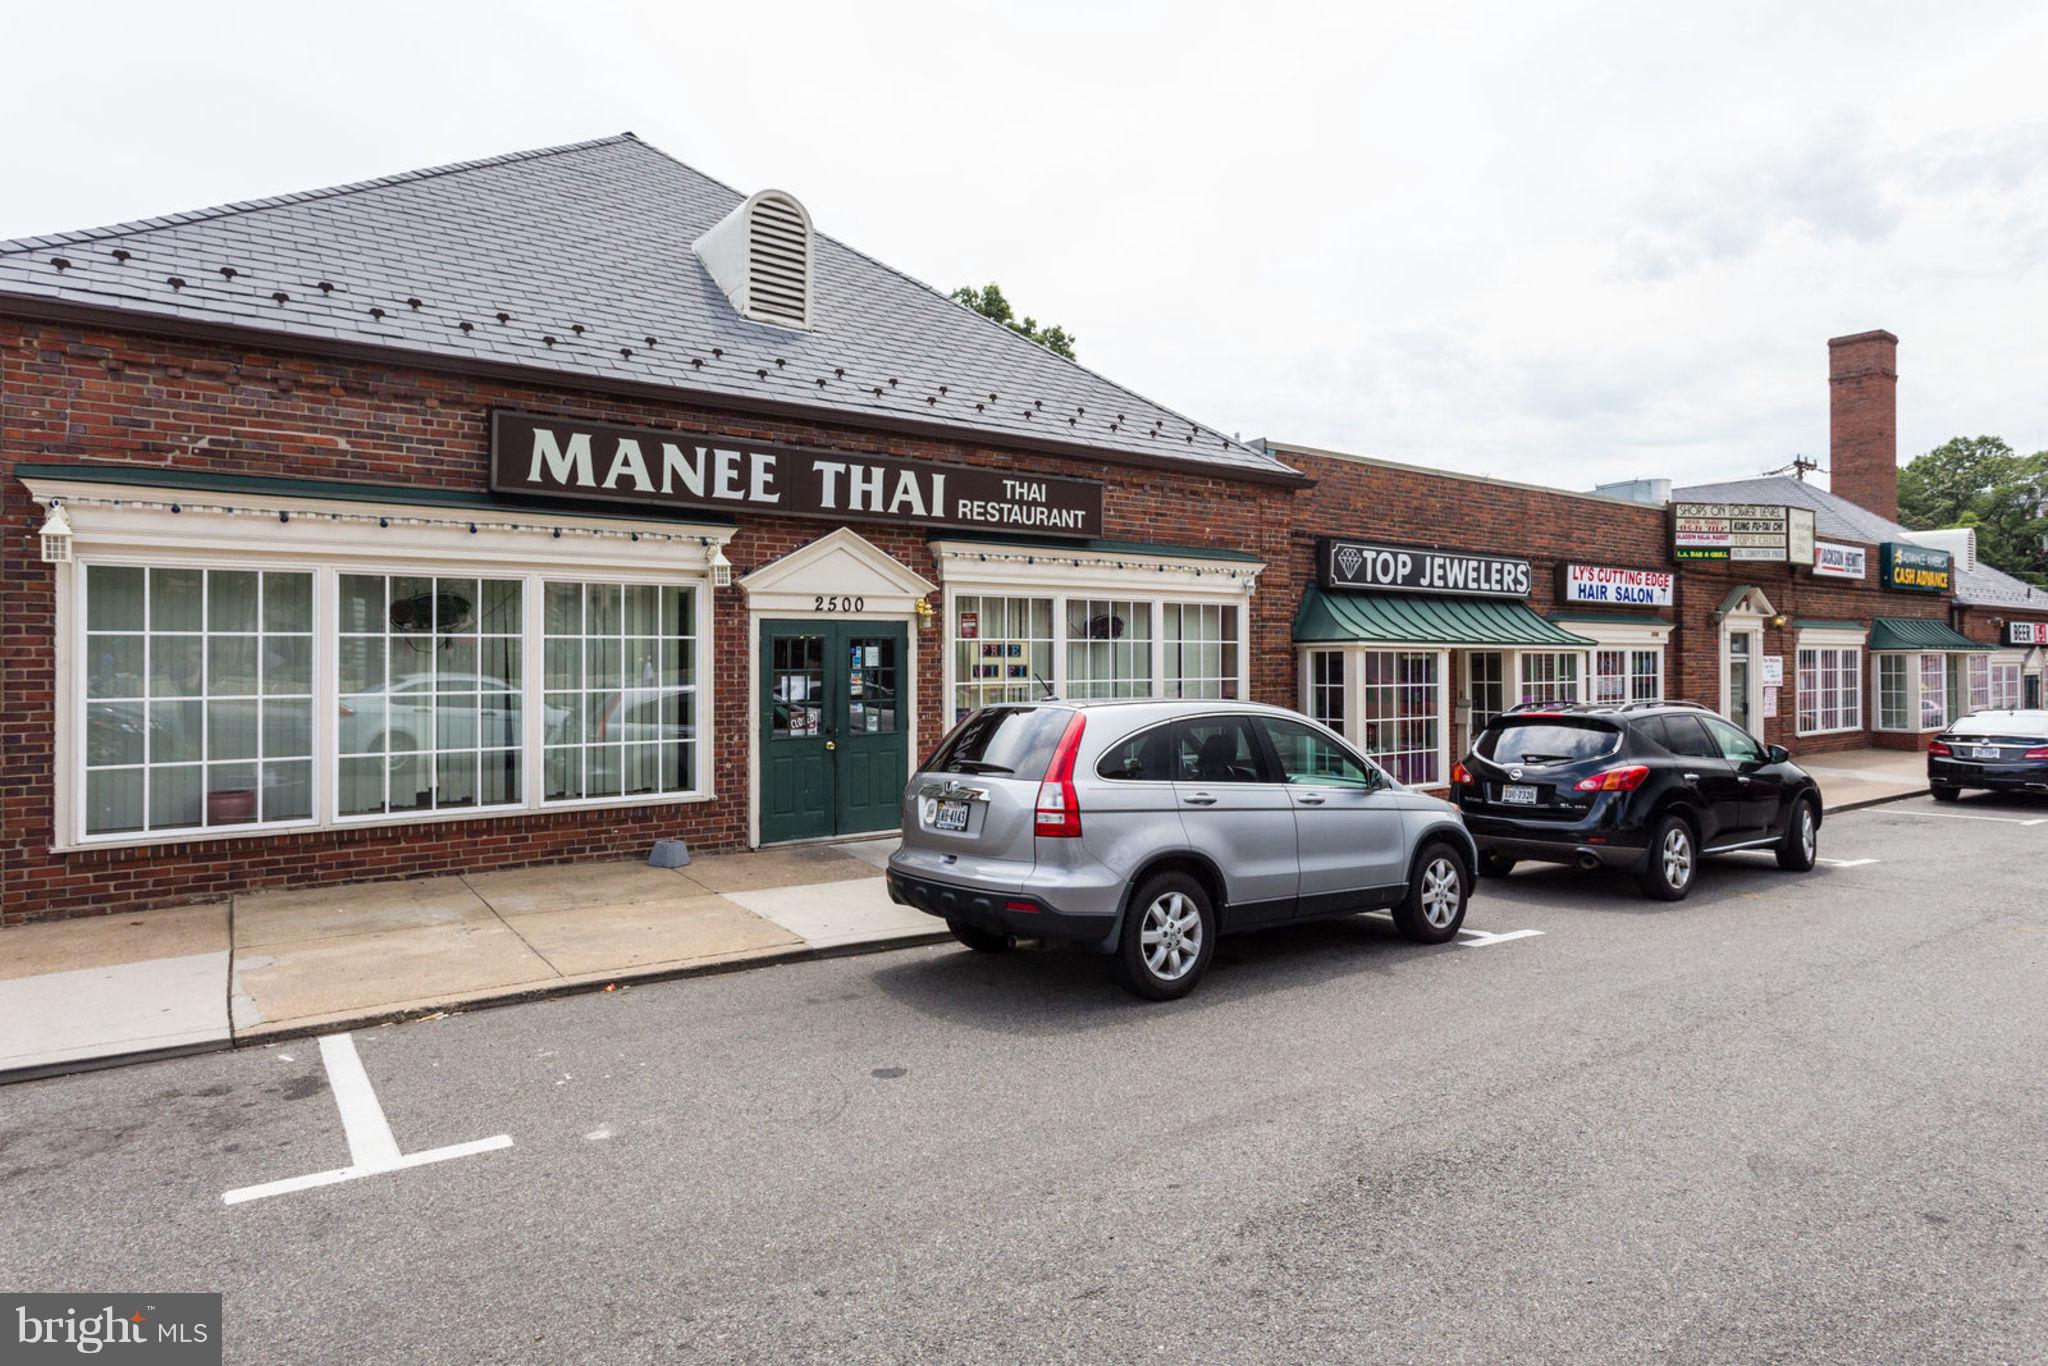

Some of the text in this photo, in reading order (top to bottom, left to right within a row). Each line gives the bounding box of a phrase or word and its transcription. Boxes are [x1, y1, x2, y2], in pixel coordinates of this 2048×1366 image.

[527, 426, 946, 517] MANEE THAI
[1003, 479, 1048, 502] THAI
[957, 499, 1086, 529] RESTAURANT
[1679, 504, 1781, 517] SHOPS ON LOWER LEVEL
[1733, 521, 1750, 531] KUNG
[1772, 522, 1783, 531] CHI
[1758, 535, 1783, 545] CHINA
[1362, 549, 1528, 593] TOP JEWELERS
[1572, 566, 1670, 588] LY'S CUTTING EDGE
[1893, 566, 1949, 589] CASH ADVANCE
[1578, 583, 1654, 604] HAIR SALON
[814, 595, 865, 614] 2500
[2013, 624, 2031, 641] BEER
